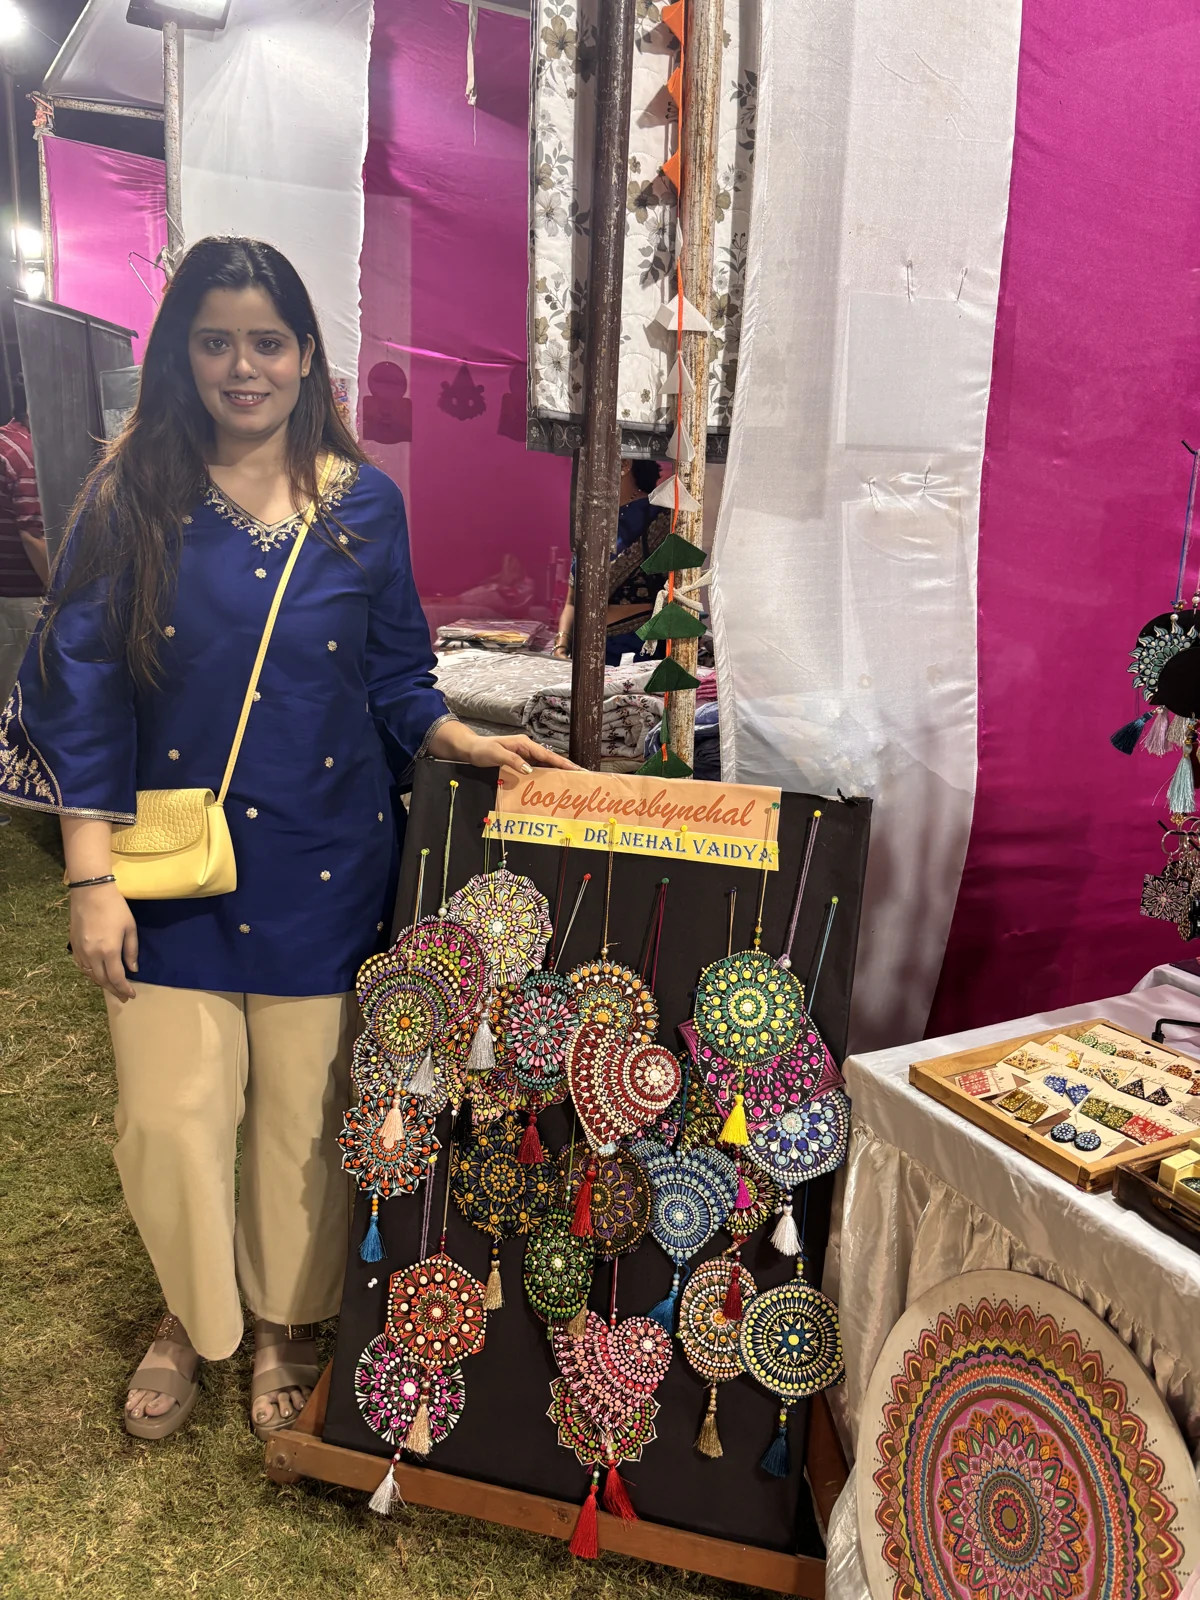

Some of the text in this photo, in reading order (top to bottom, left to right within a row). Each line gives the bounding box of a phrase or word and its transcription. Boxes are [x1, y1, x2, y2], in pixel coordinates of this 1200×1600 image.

[520, 779, 757, 828] loopylinesbynehal
[619, 831, 686, 853] NEHAL
[693, 838, 773, 863] VAIDYA
